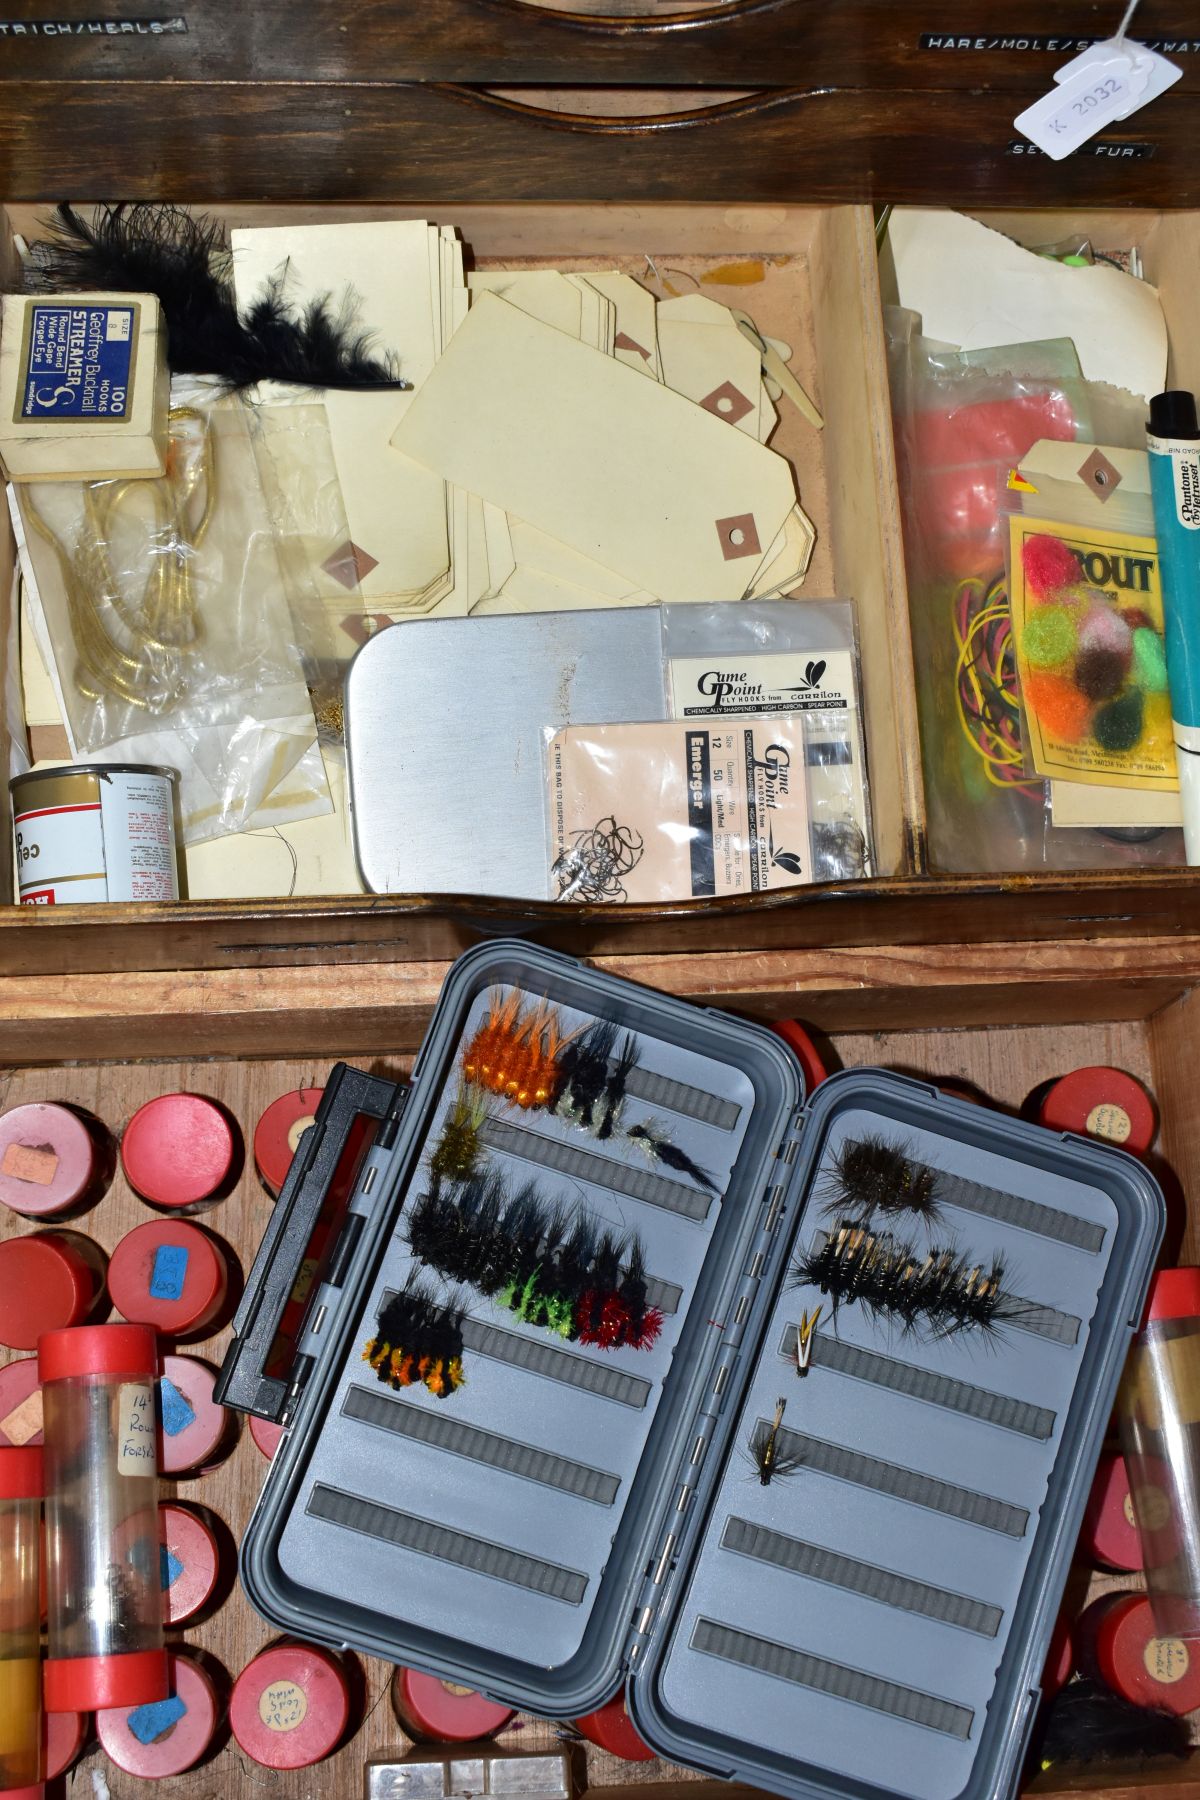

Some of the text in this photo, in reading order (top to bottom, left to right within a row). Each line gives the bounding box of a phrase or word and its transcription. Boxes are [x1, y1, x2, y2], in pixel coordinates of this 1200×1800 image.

[1049, 79, 1123, 134] K 2032
[1095, 146, 1142, 157] FUR.
[34, 315, 48, 363] Forged Eye
[45, 316, 58, 364] Wide Gape
[55, 315, 68, 368] Round Bend
[121, 318, 129, 335] SIZE
[65, 310, 87, 387] STREAMER
[81, 312, 105, 412] Geoffrey Bucknall
[26, 381, 36, 415] sundridge
[98, 379, 111, 412] HOOKS
[110, 386, 126, 412] 100
[697, 671, 747, 696] Game
[713, 682, 763, 708] Point
[722, 696, 737, 704] FLY
[738, 695, 766, 703] HOOKS
[685, 700, 844, 716] CHEMICALLY SHARPENED HIGH CARBON SPEAR POINT
[712, 737, 722, 749] 12
[745, 731, 753, 769] CHEMICALLY
[689, 736, 704, 809] Emerger
[713, 769, 723, 781] 50
[747, 769, 755, 803] SHARPENED
[753, 758, 779, 810] Point
[764, 743, 790, 795] Game
[715, 794, 725, 828] Light/Med
[757, 785, 765, 812] HOOKS
[556, 801, 564, 833] DISPOSE
